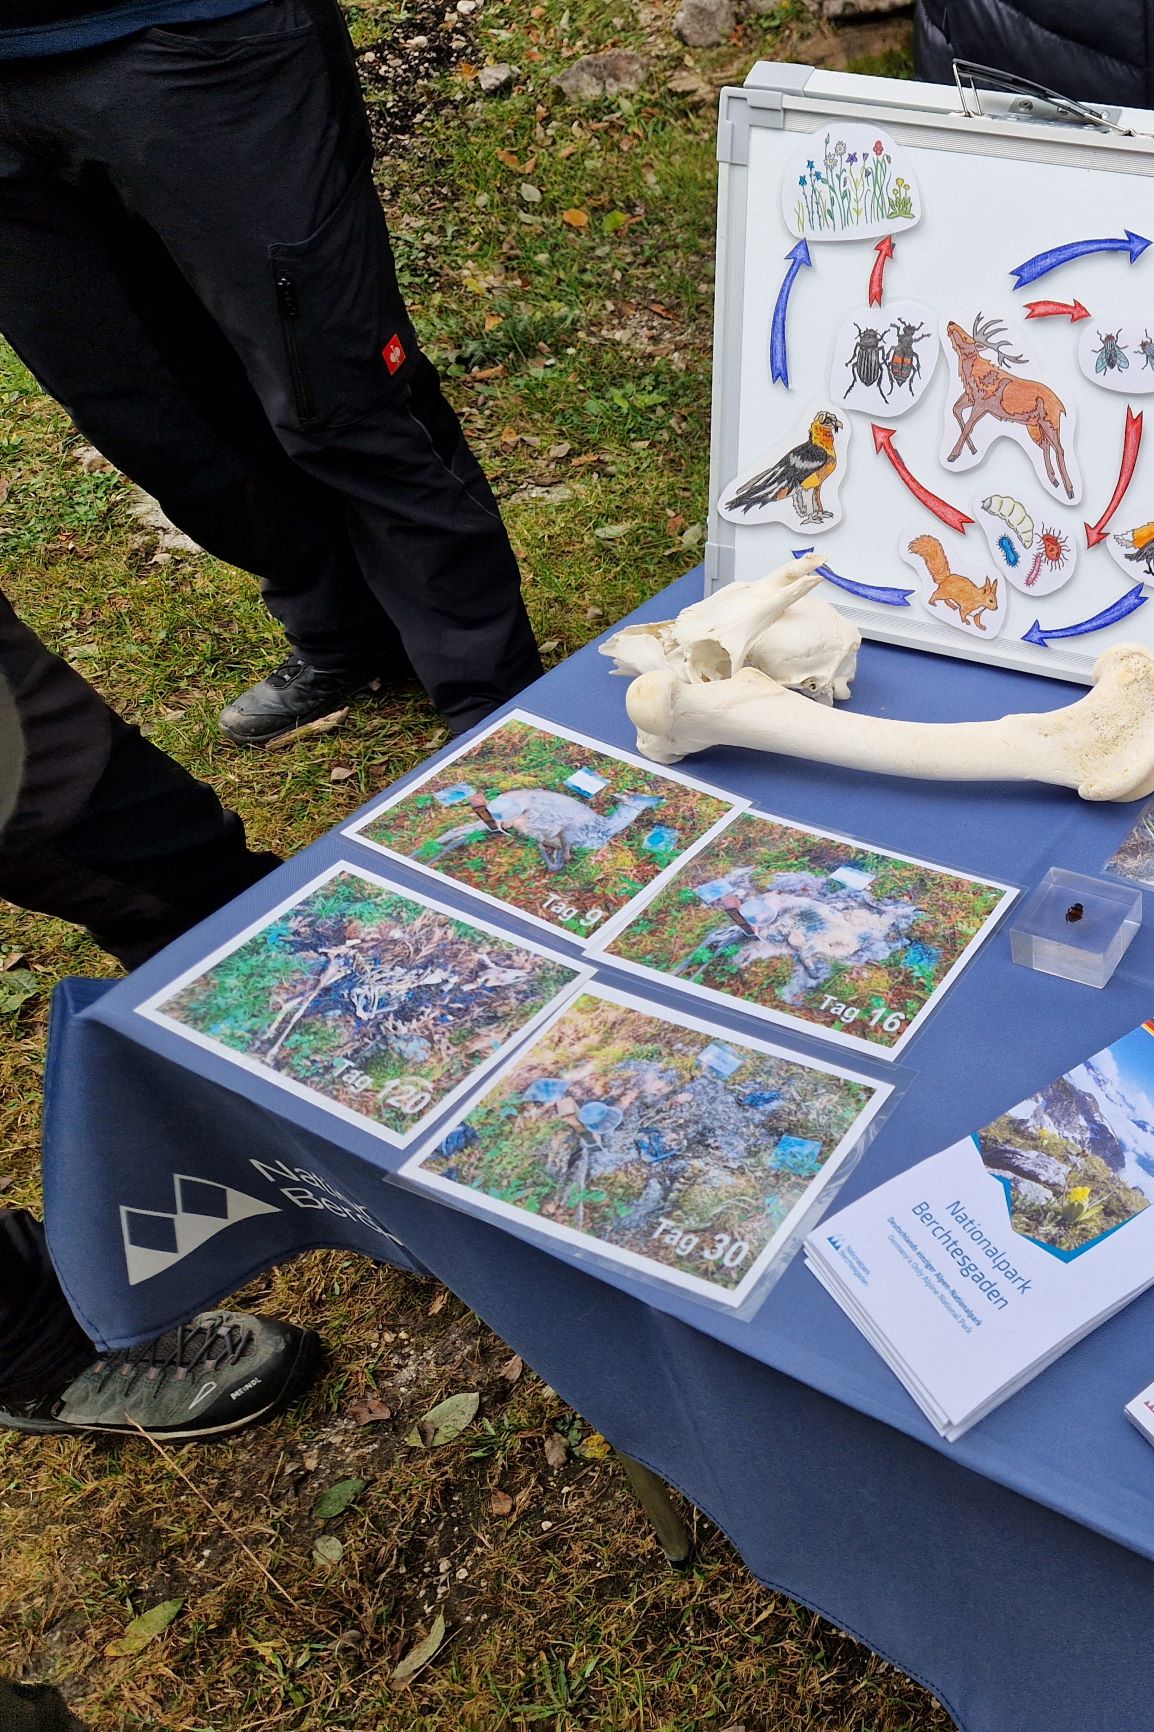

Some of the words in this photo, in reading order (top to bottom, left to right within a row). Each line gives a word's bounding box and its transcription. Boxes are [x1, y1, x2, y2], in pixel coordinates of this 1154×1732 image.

[542, 892, 579, 921] Tag
[579, 908, 604, 927] 9
[819, 994, 860, 1024] Tag
[869, 1007, 906, 1032] 16
[333, 1057, 374, 1093] Tag
[652, 1216, 699, 1256] Tag
[703, 1232, 749, 1267] 30
[912, 1201, 1008, 1310] Berchtesgaden
[945, 1200, 1032, 1296] Nationalpark
[230, 1377, 262, 1400] MEINDL
